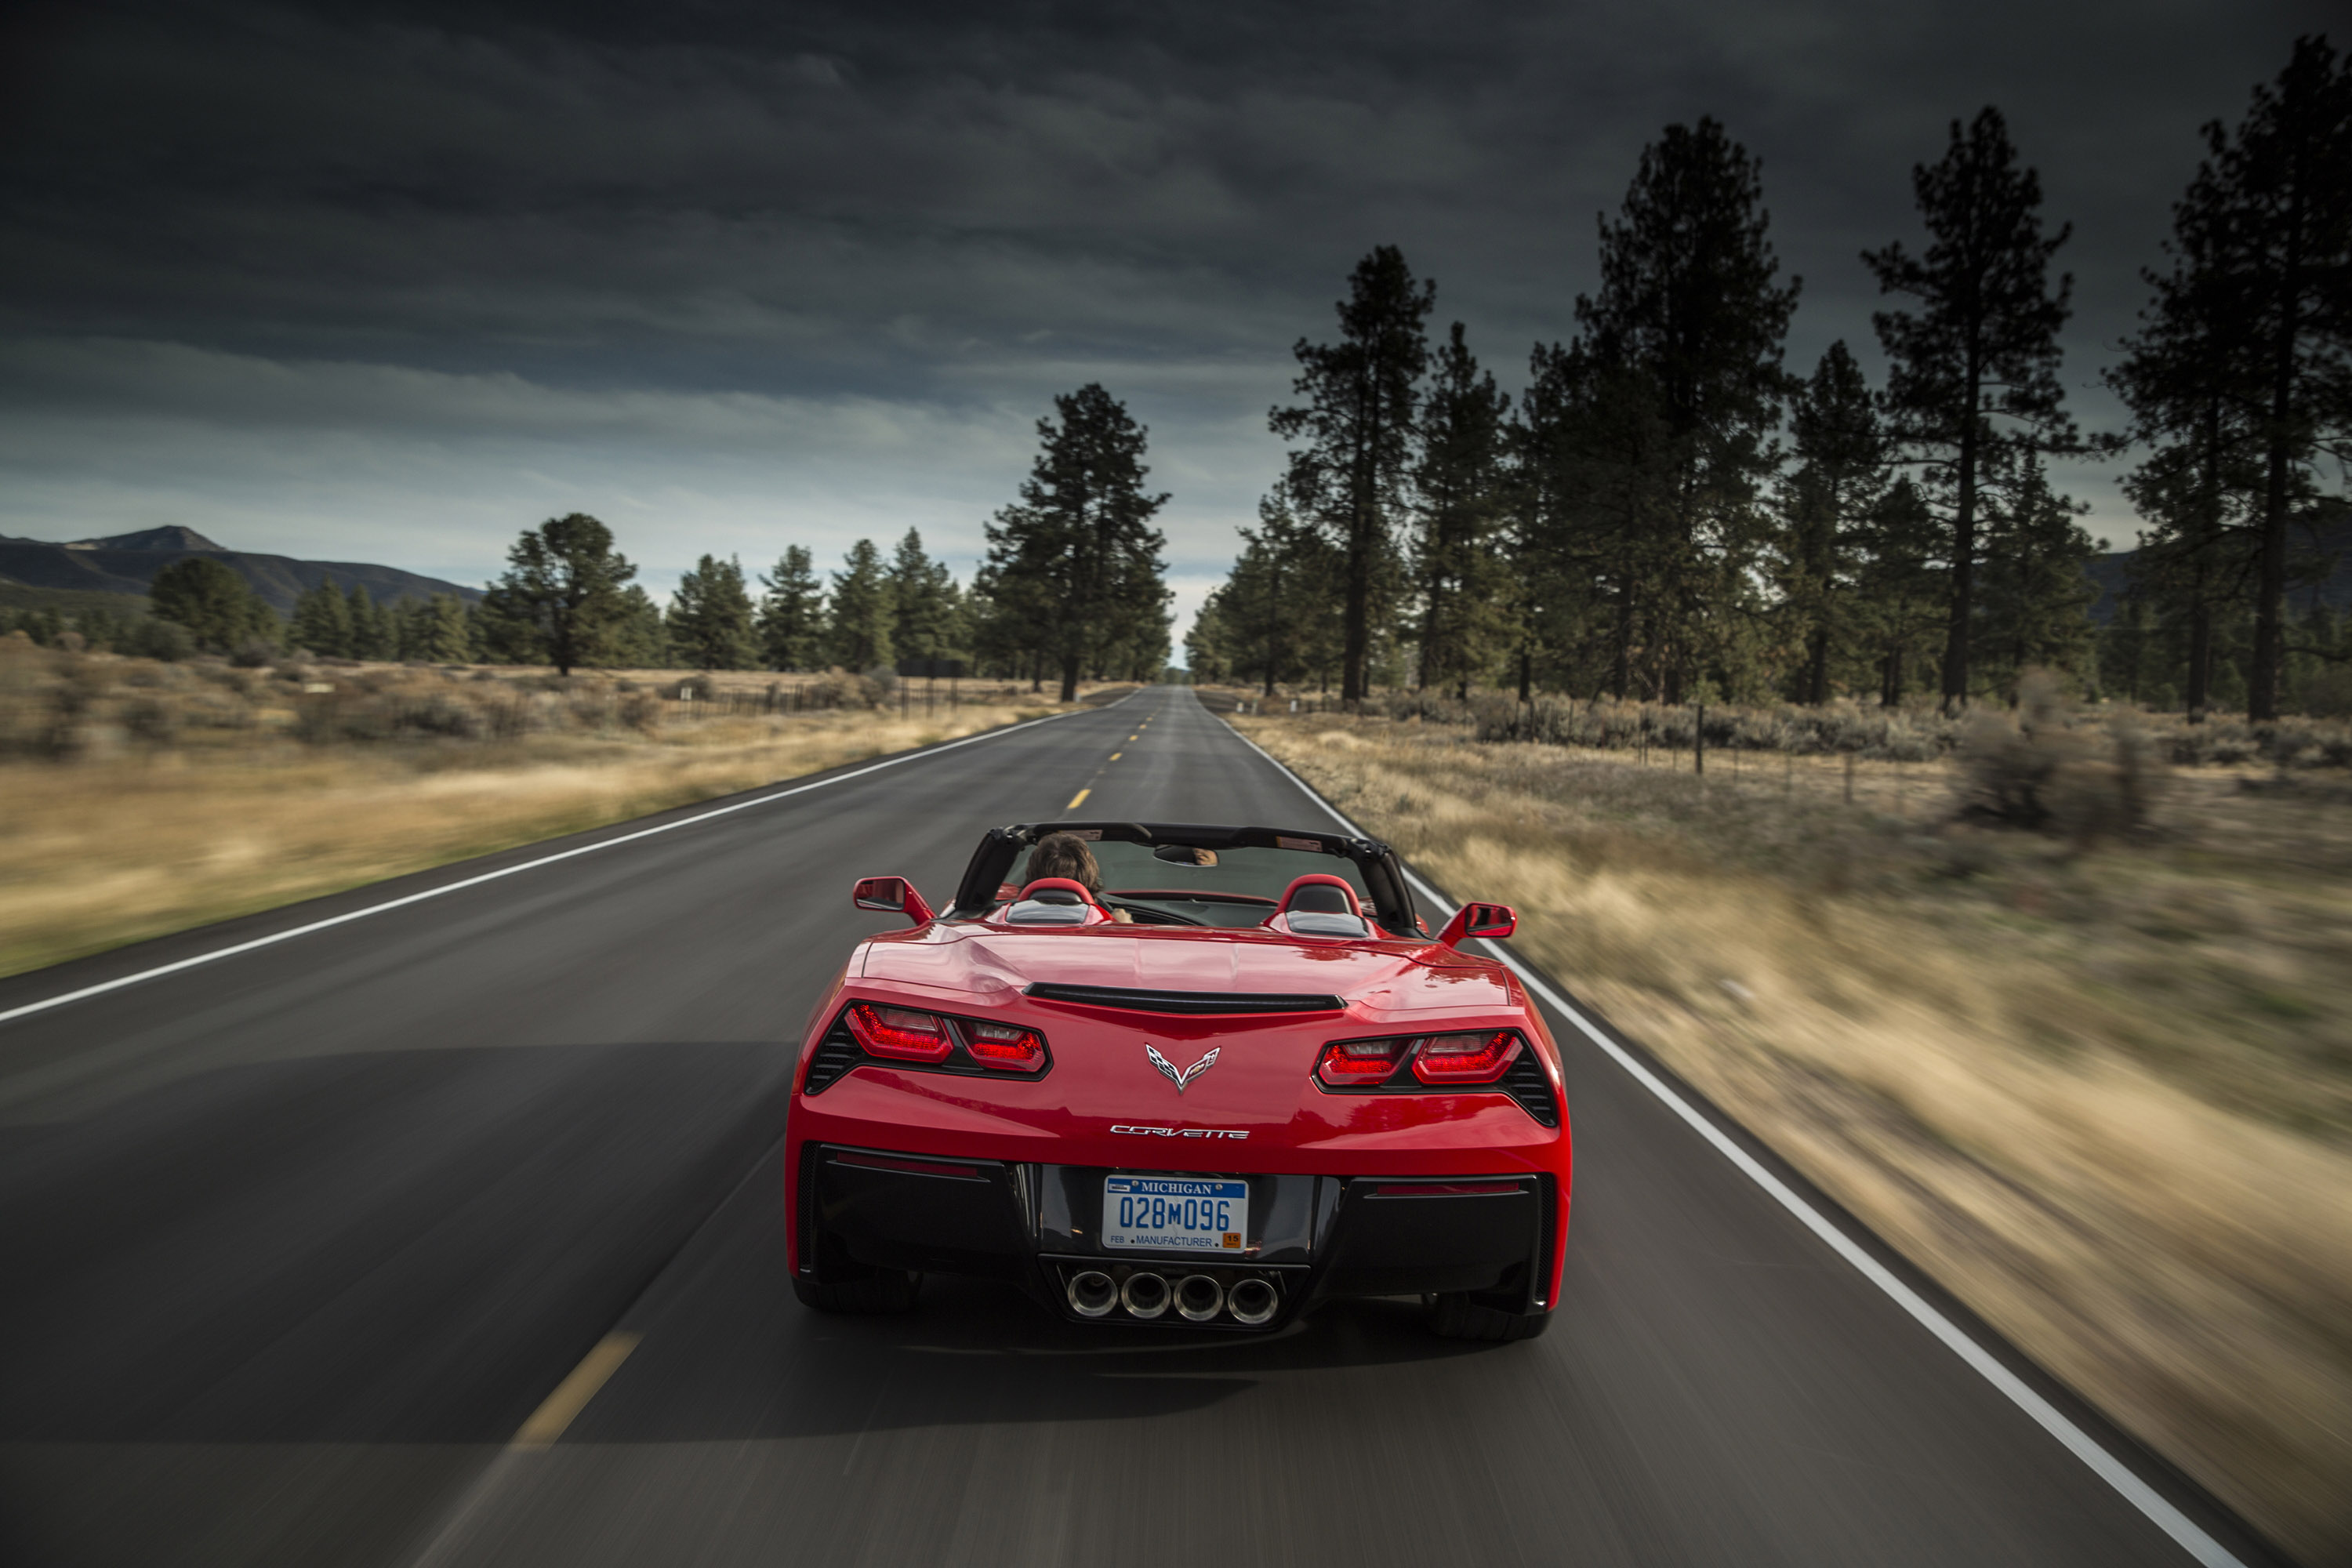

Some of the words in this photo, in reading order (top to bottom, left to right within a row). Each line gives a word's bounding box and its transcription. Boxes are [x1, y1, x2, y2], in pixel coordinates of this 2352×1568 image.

[1109, 1124, 1250, 1139] CORVETTE
[1141, 1181, 1212, 1195] MICHIGAN
[1120, 1196, 1230, 1232] 028M096
[1136, 1236, 1213, 1247] MANUFACTURER
